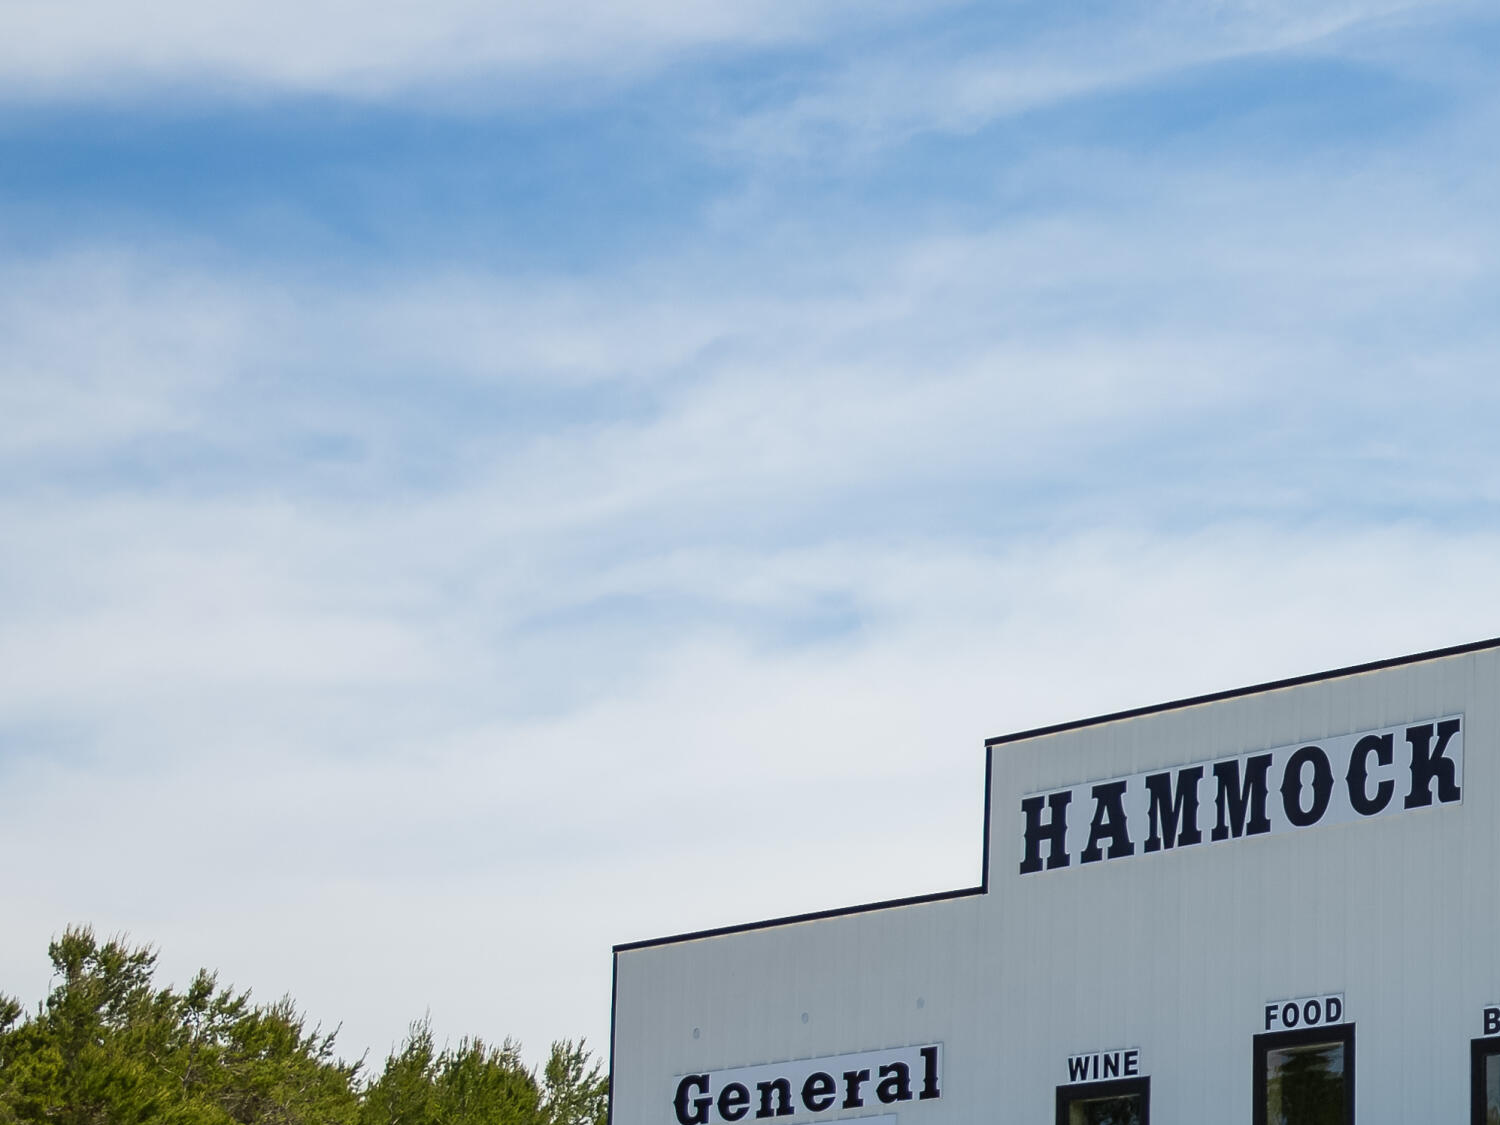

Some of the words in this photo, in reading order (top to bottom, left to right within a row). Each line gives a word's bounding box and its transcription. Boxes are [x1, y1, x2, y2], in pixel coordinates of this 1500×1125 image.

[1020, 718, 1461, 875] HAMMOCK
[1265, 997, 1343, 1031] FOOD
[1068, 1050, 1139, 1082] WINE
